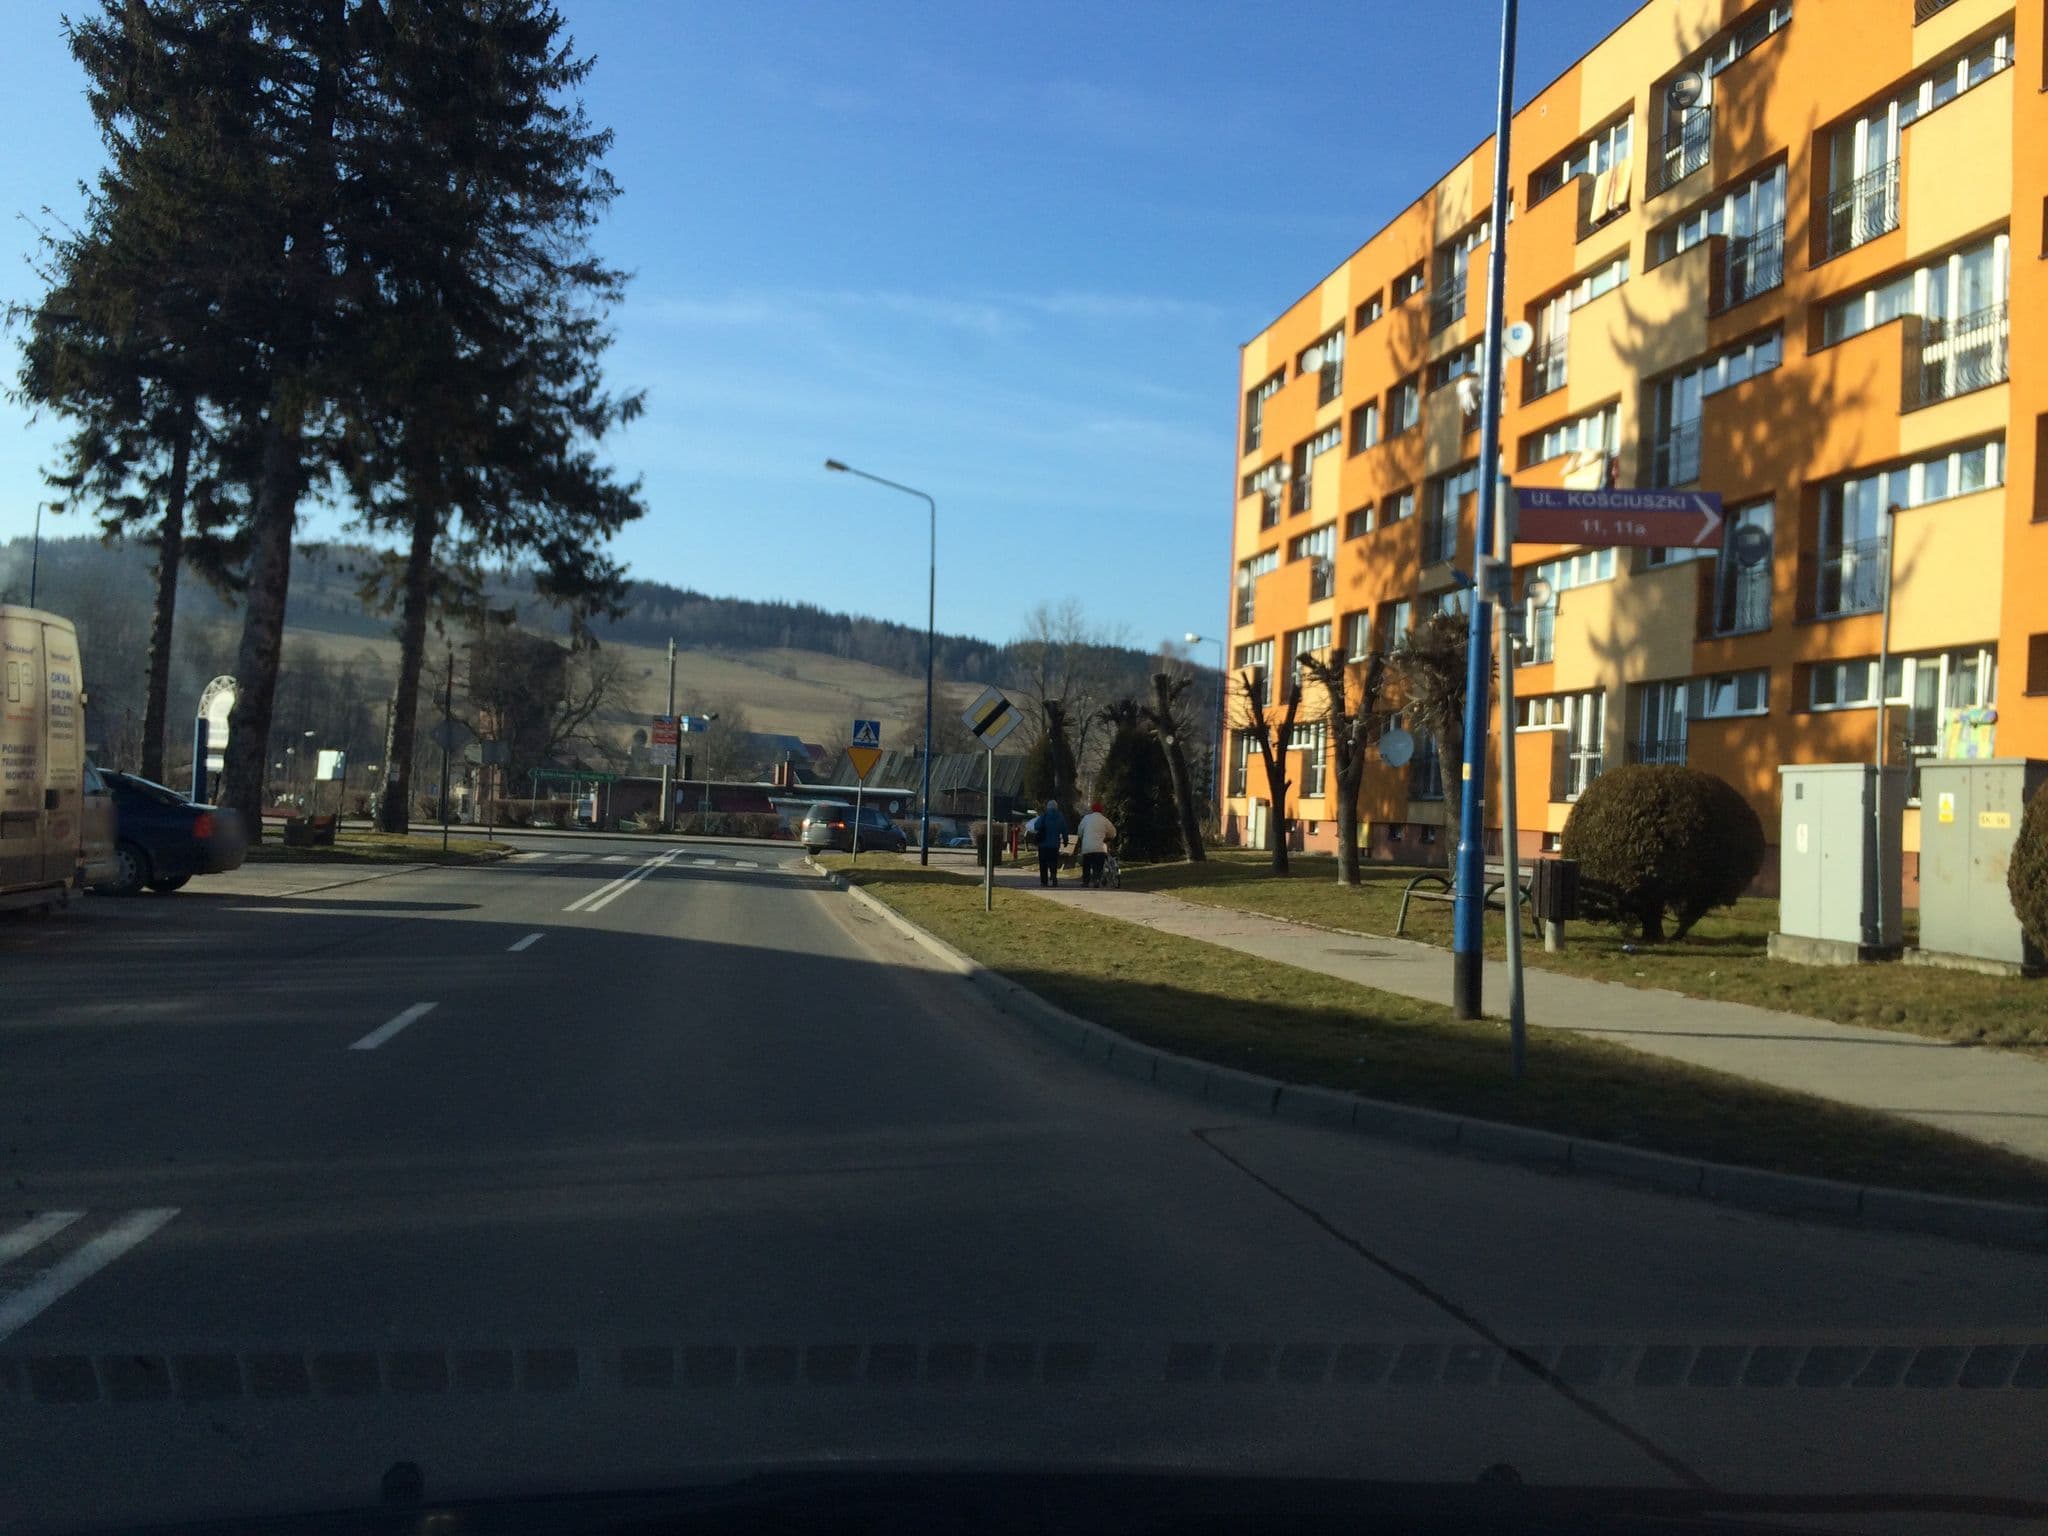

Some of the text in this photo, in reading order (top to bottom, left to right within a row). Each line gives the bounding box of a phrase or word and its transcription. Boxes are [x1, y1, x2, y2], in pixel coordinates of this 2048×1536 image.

[1531, 491, 1686, 510] UL. KOŚCIUSZKI
[1615, 520, 1648, 536] 11a
